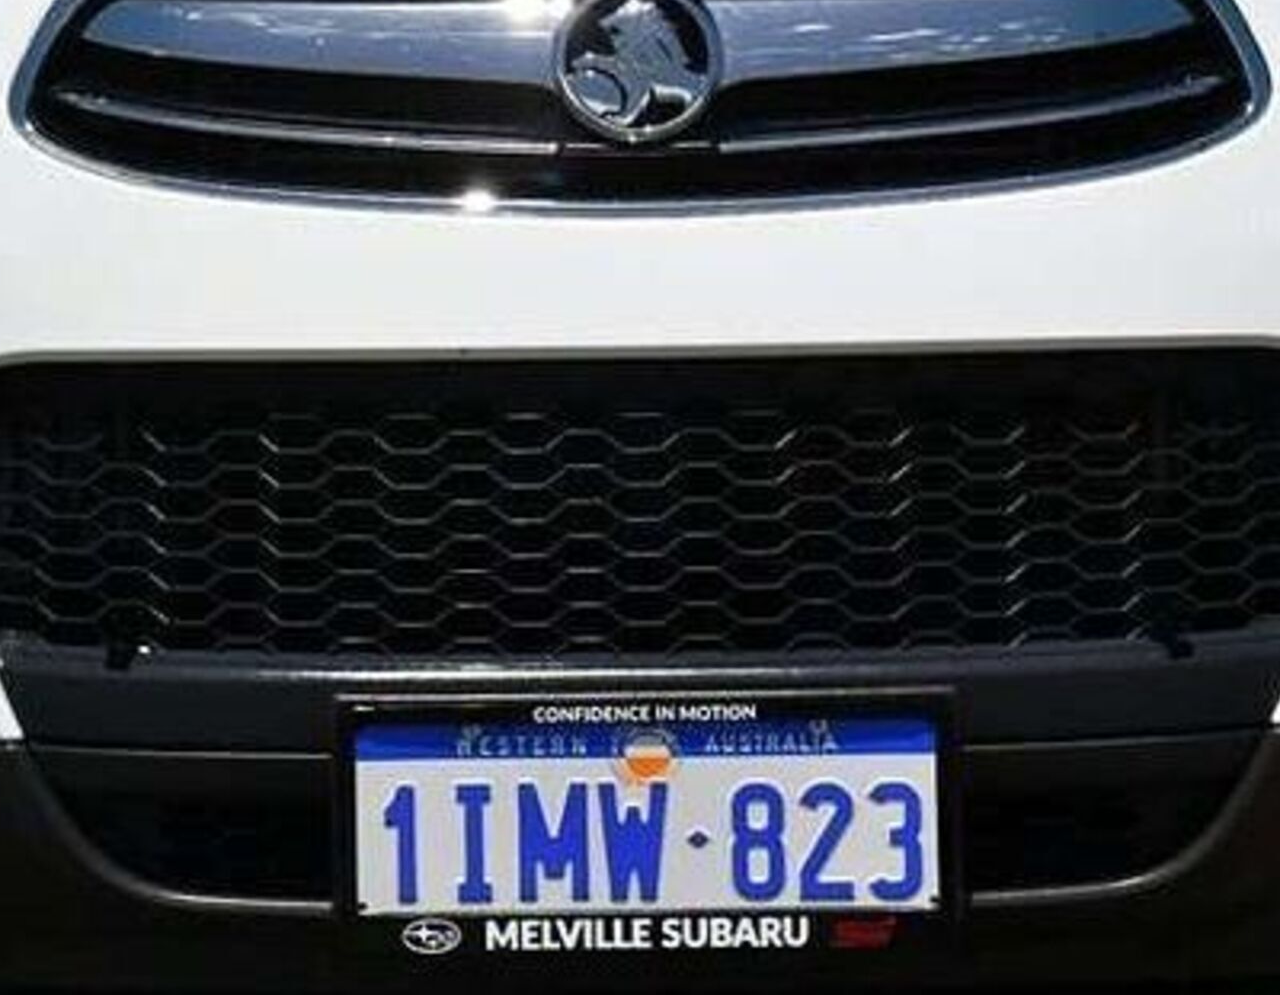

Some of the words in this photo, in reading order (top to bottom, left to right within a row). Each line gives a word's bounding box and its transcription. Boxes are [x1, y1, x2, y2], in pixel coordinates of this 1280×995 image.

[532, 705, 649, 723] CONFIDENCE
[655, 705, 675, 721] IN
[678, 703, 757, 722] MOTION
[704, 730, 840, 754] AUSTRALIA
[484, 918, 653, 951] MELVILLE
[660, 915, 810, 949] SUBARU
